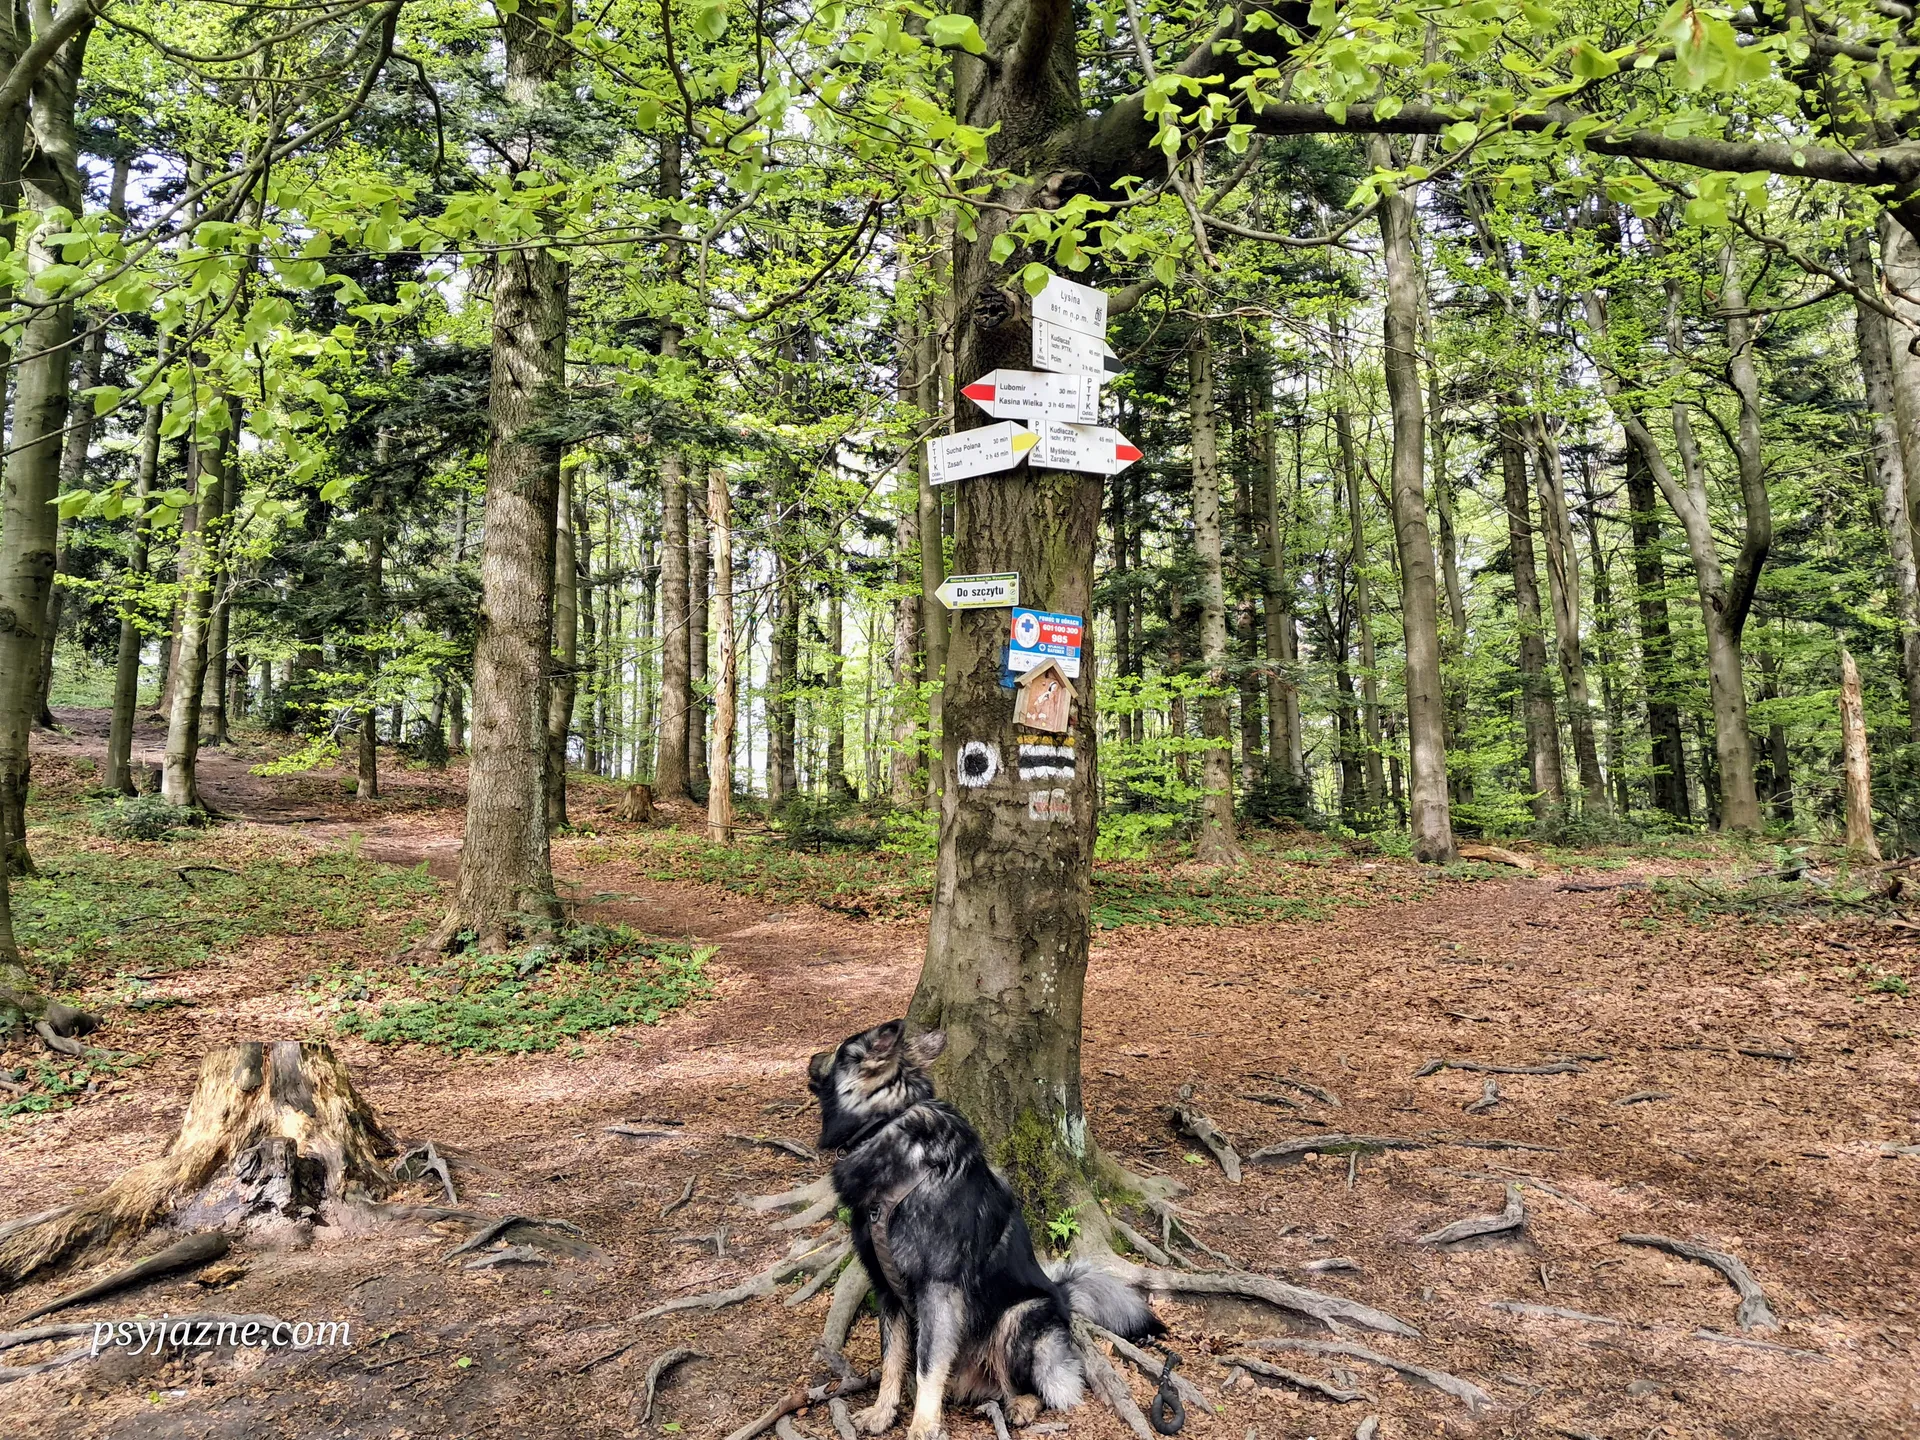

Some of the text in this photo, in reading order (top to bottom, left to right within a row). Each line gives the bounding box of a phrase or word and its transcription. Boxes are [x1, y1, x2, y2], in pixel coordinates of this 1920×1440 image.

[1050, 304, 1060, 313] 891
[1000, 382, 1026, 392] Lubomir
[946, 447, 962, 455] Sucha
[1050, 455, 1070, 463] Zarabie
[957, 586, 1004, 597] Do szczytu
[1052, 634, 1068, 643] 985
